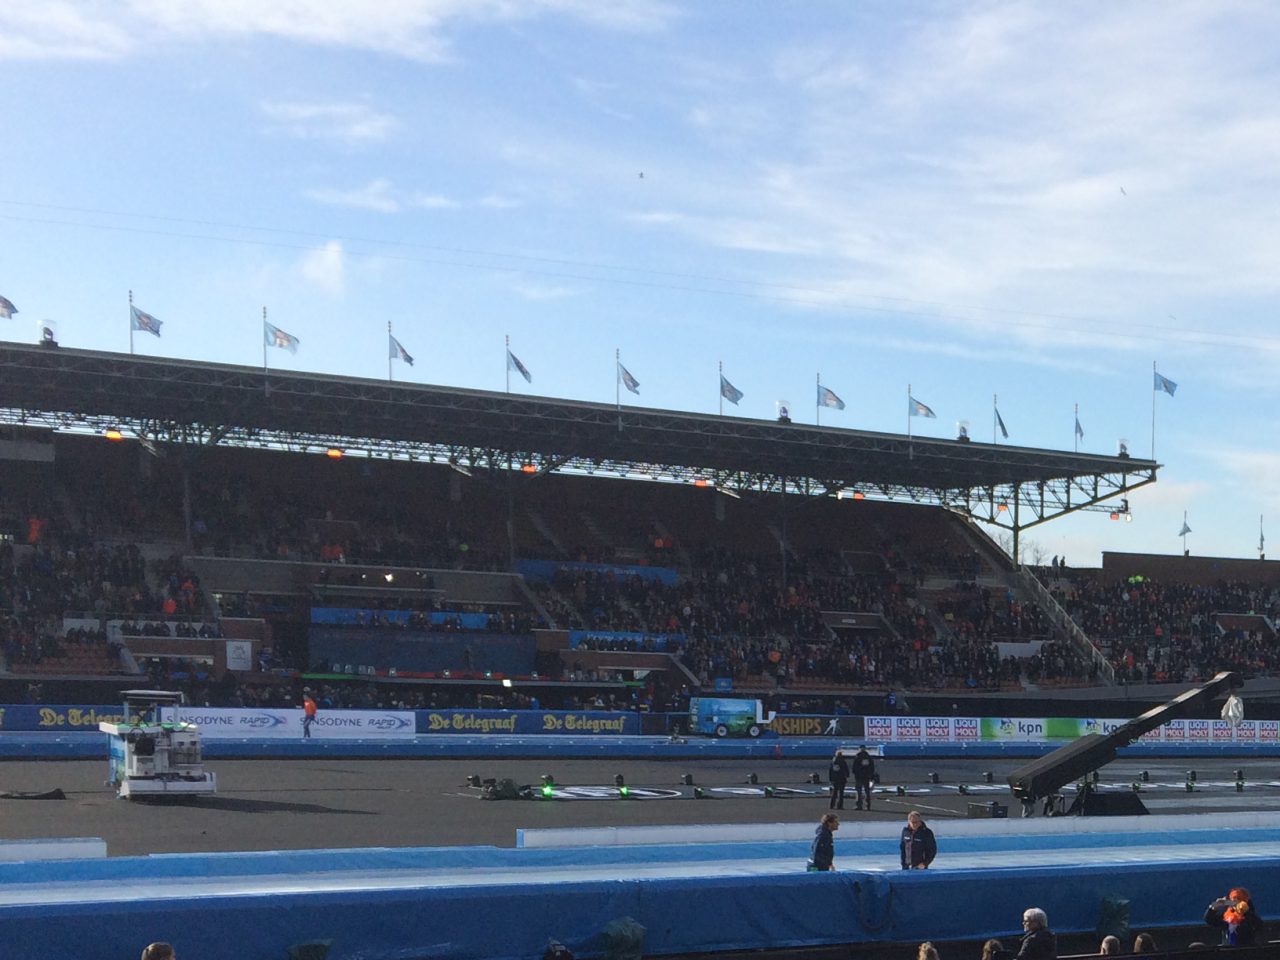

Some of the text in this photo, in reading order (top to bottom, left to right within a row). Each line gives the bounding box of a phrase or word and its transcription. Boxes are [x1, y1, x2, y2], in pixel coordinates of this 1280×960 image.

[40, 708, 64, 726] De
[166, 715, 233, 725] SNSODYNE
[300, 717, 362, 727] SNSODYNE
[429, 714, 518, 732] De Telegraaf
[543, 714, 626, 733] De Telegraaf
[868, 719, 891, 727] LIQUI
[897, 719, 920, 727] LIQUI
[927, 719, 949, 727] LIQUI
[868, 728, 891, 736] MOLY
[898, 728, 920, 736] MOLY
[927, 728, 949, 736] MOLY
[956, 728, 977, 736] MOLY
[1019, 721, 1043, 736] kpn
[1166, 729, 1184, 737] MOLY
